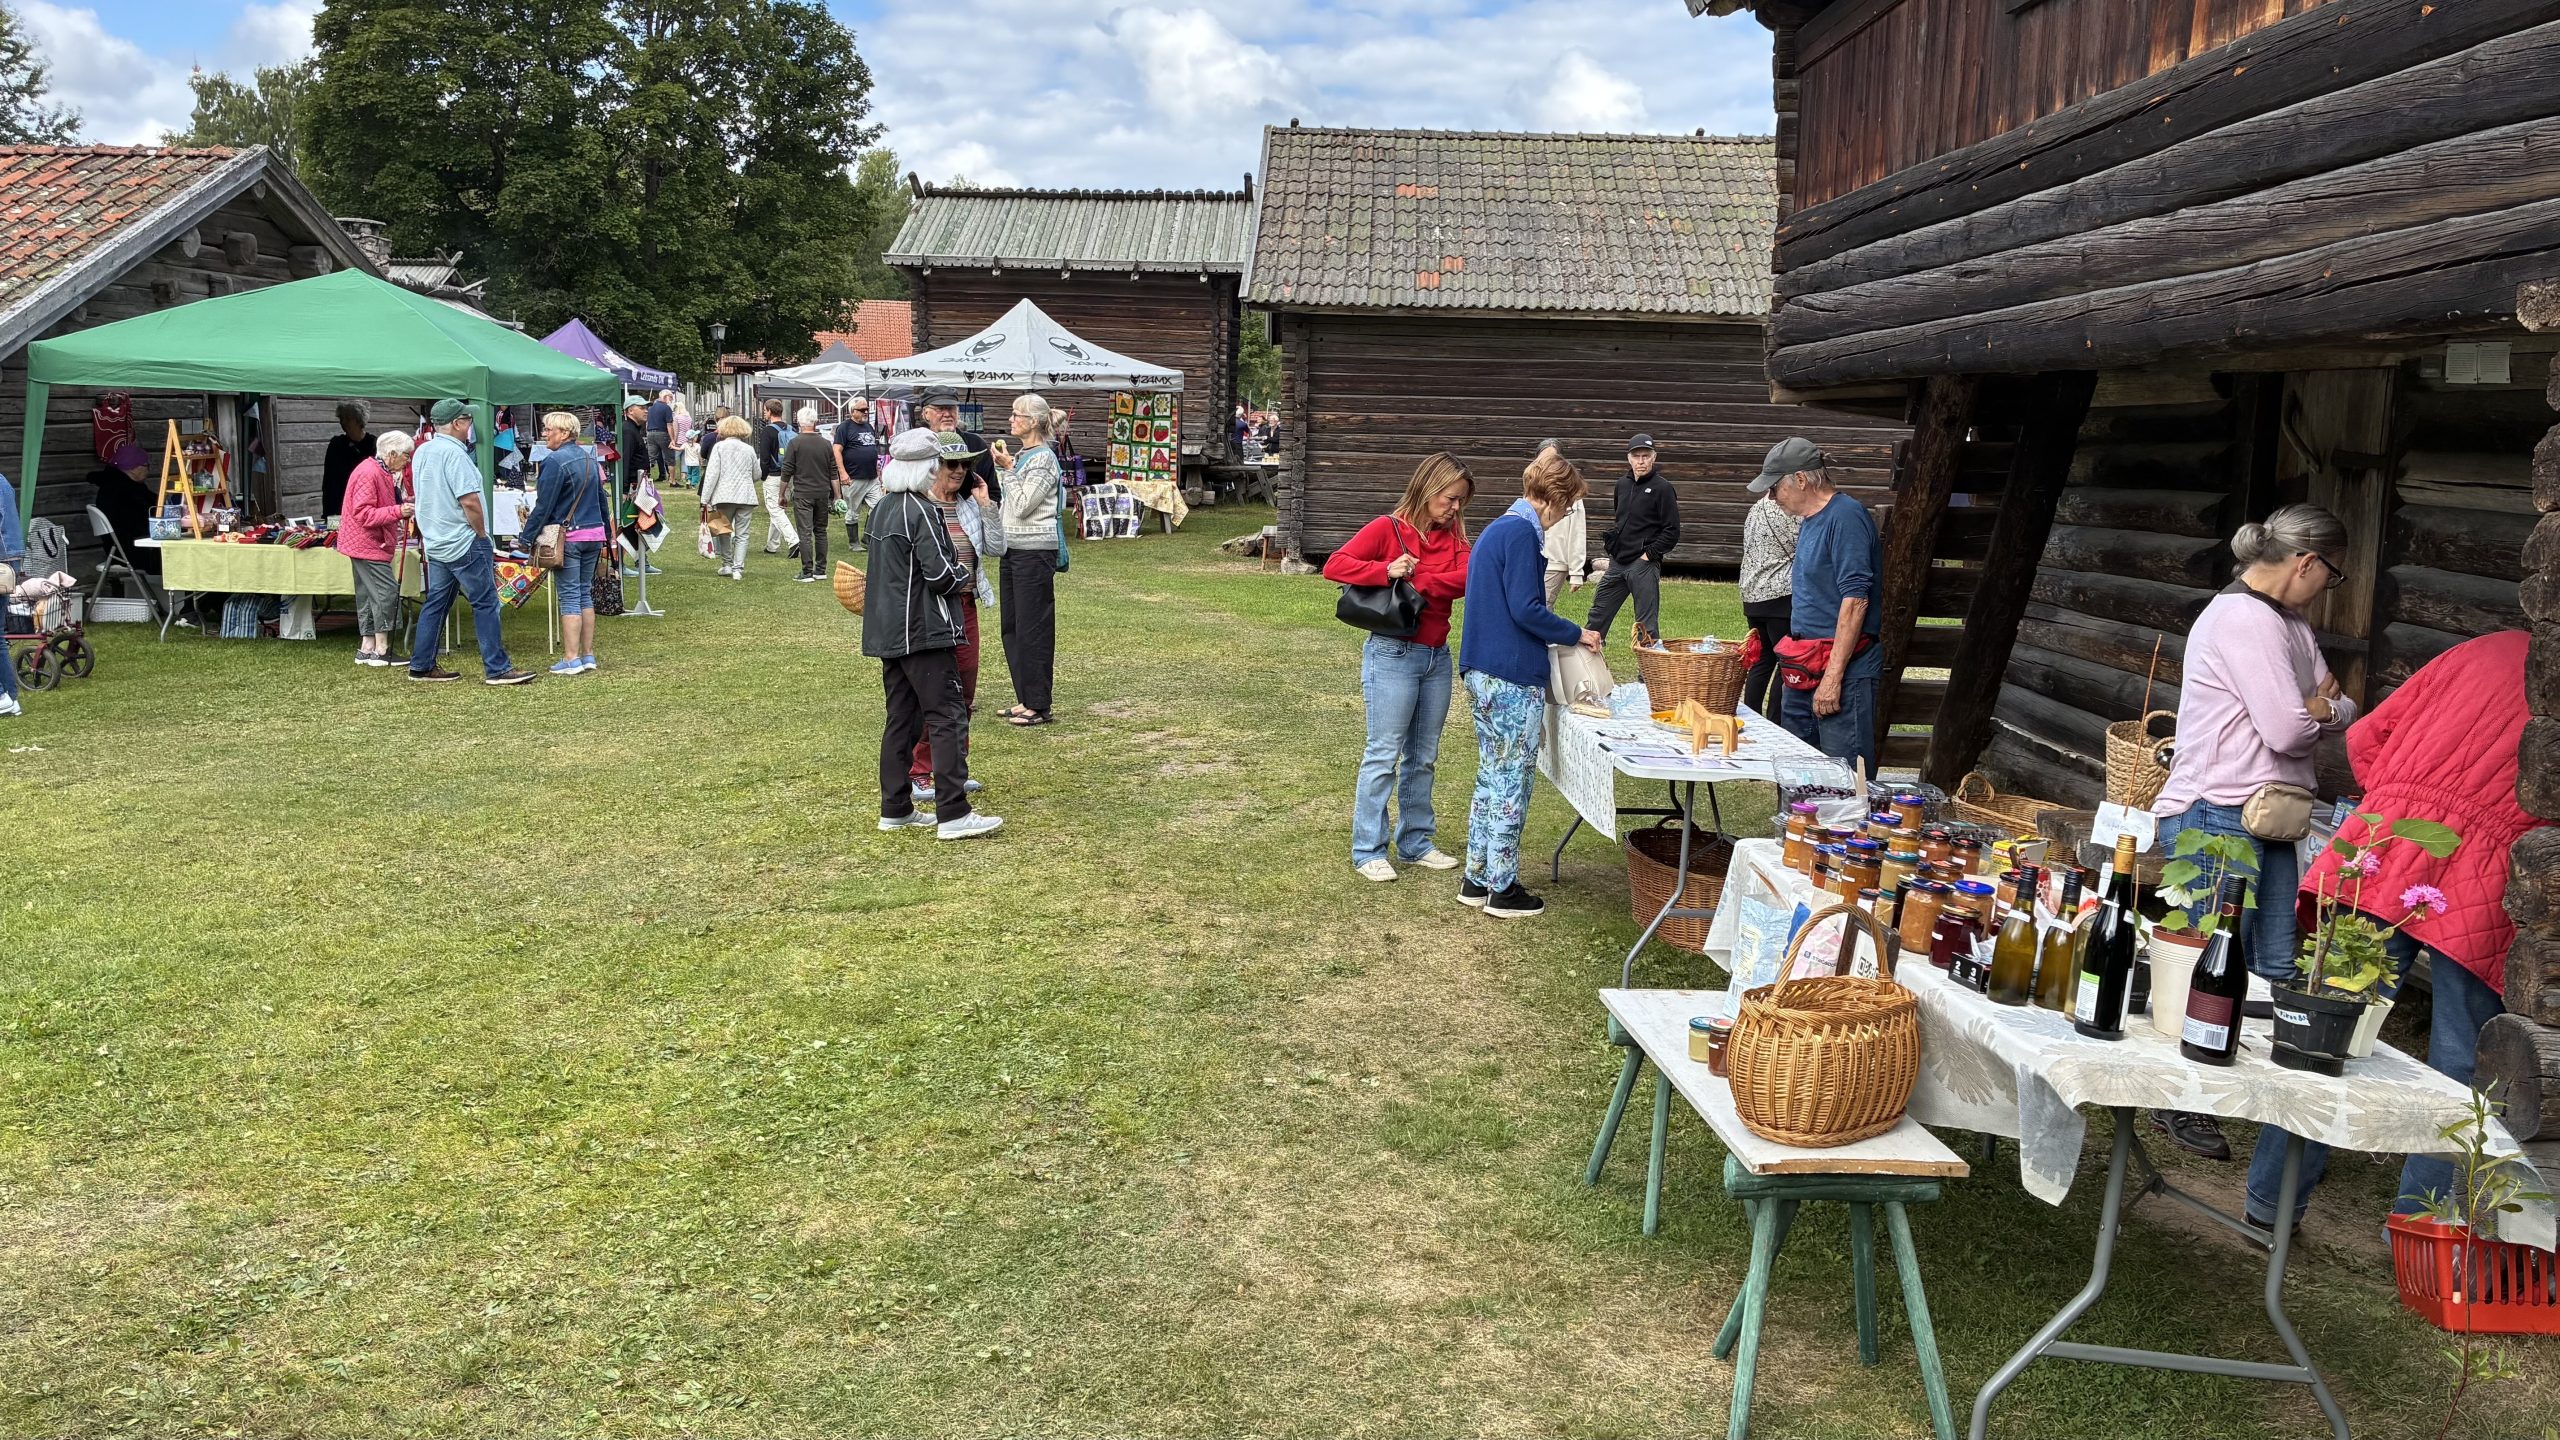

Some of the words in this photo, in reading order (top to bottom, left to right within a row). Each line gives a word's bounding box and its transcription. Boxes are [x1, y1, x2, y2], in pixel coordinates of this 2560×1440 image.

[891, 368, 927, 378] 24MX
[976, 371, 1015, 381] 24MX
[1060, 373, 1096, 382] 24MX
[1140, 375, 1173, 385] 24MX
[1955, 960, 1961, 970] 2
[1970, 967, 1977, 977] 3
